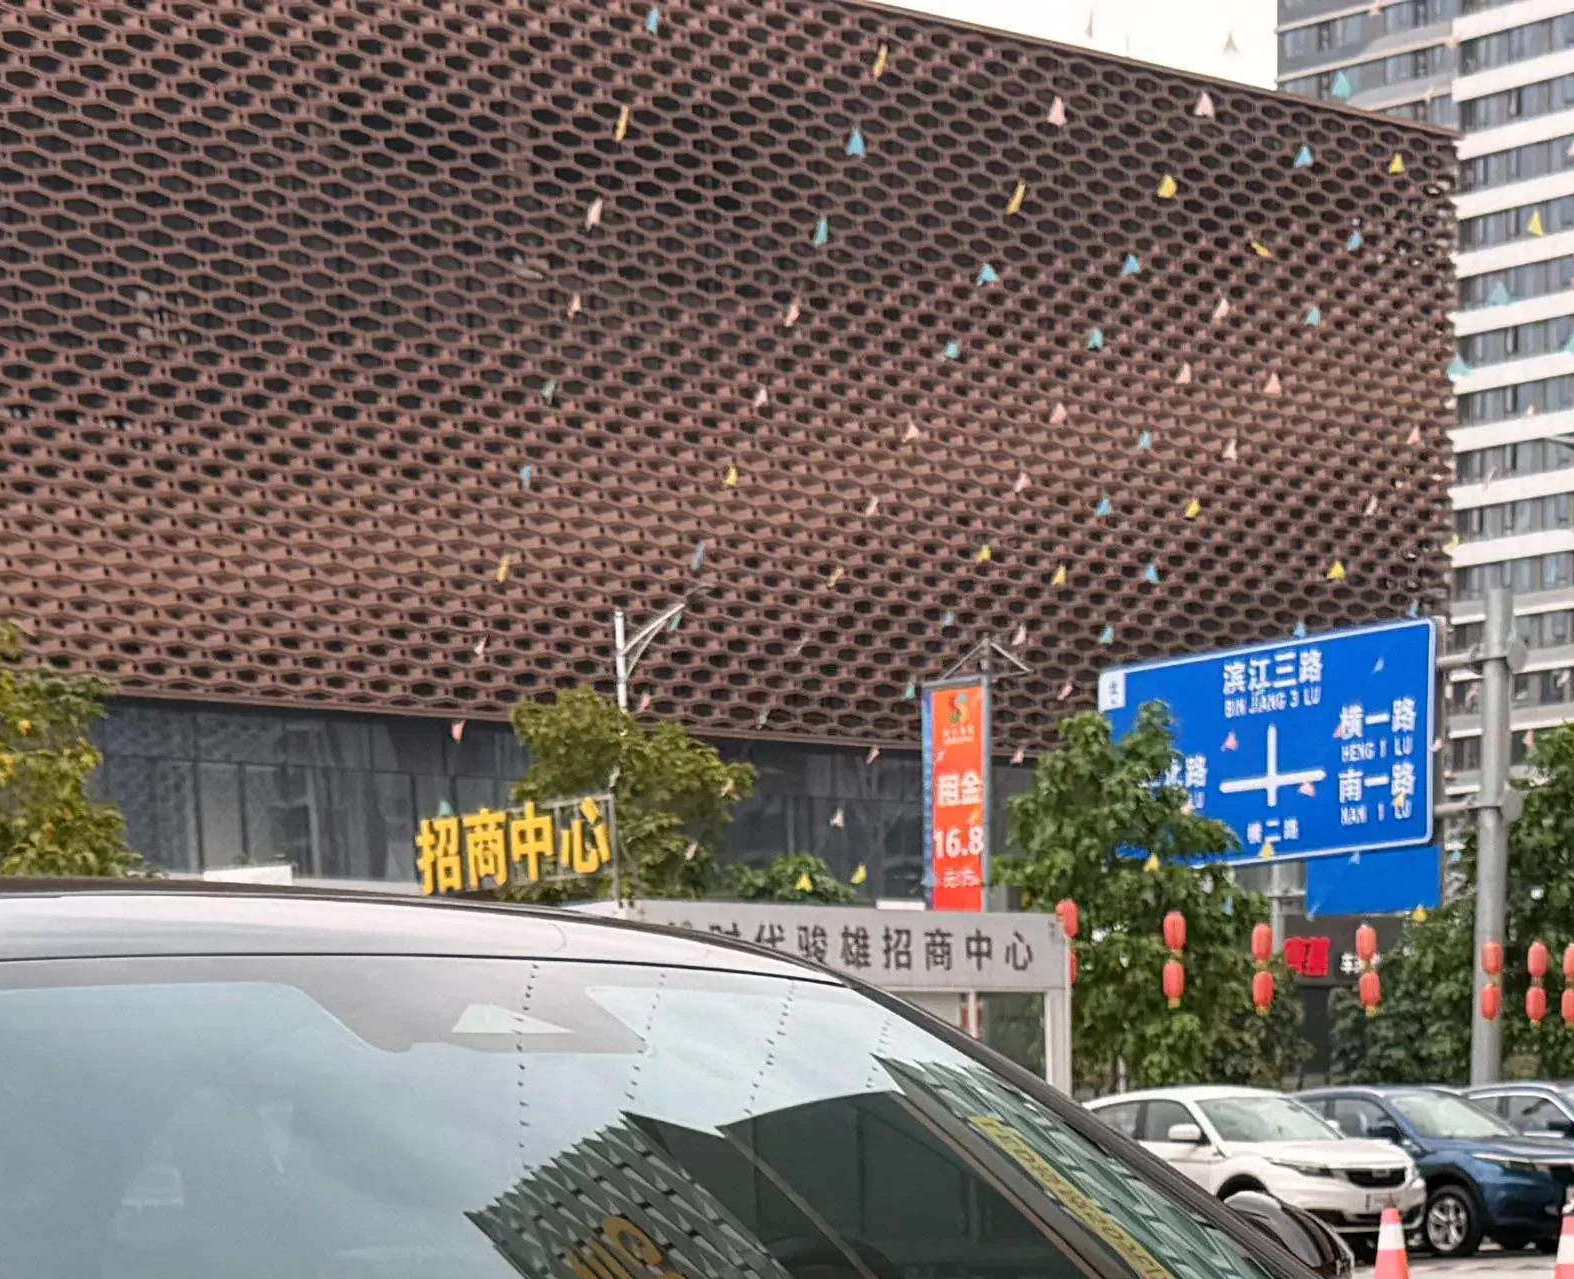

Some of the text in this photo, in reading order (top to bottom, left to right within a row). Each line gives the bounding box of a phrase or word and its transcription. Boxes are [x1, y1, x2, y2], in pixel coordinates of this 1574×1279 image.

[1223, 650, 1323, 695] 滨江三路
[1338, 763, 1416, 804] 南一路
[415, 797, 612, 896] 招商中心
[934, 825, 984, 860] 16.8
